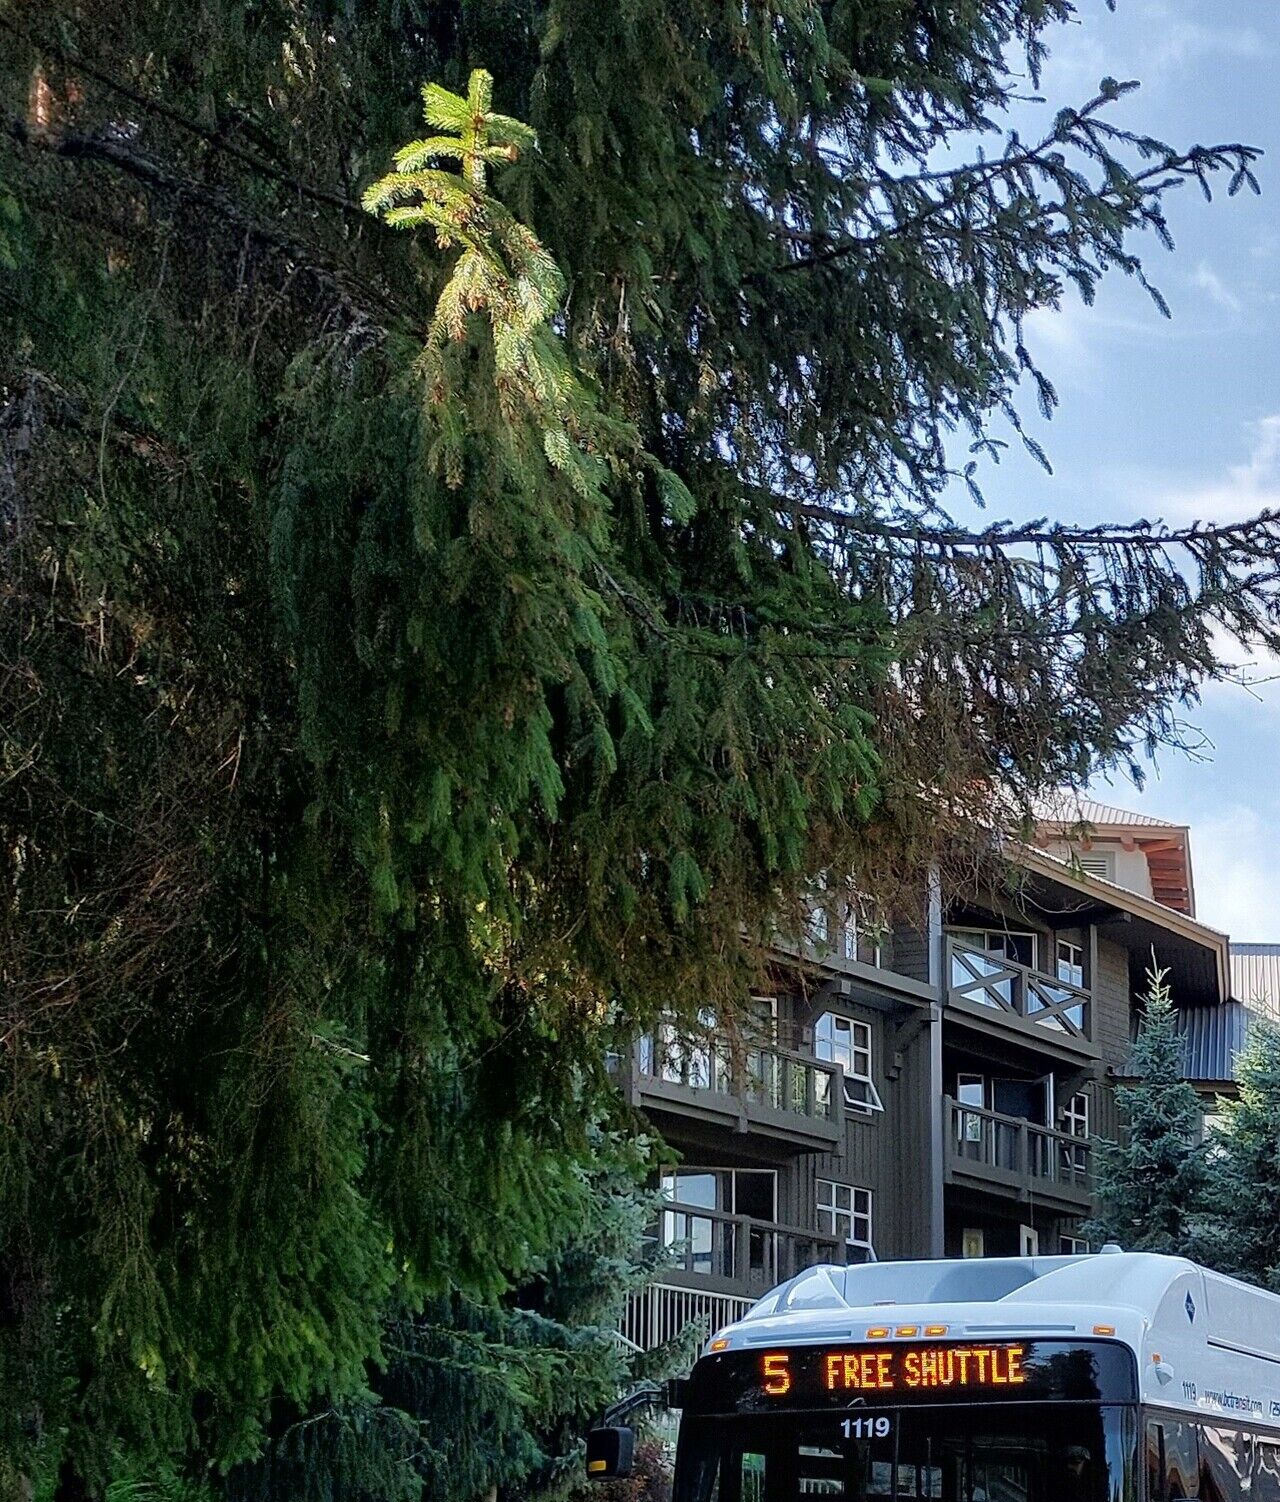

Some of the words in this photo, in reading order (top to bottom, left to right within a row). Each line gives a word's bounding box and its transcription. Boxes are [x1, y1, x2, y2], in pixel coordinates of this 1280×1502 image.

[763, 1354, 791, 1394] 5
[826, 1353, 894, 1390] FREE
[904, 1349, 1026, 1387] SHUTTLE
[840, 1416, 890, 1439] 1119
